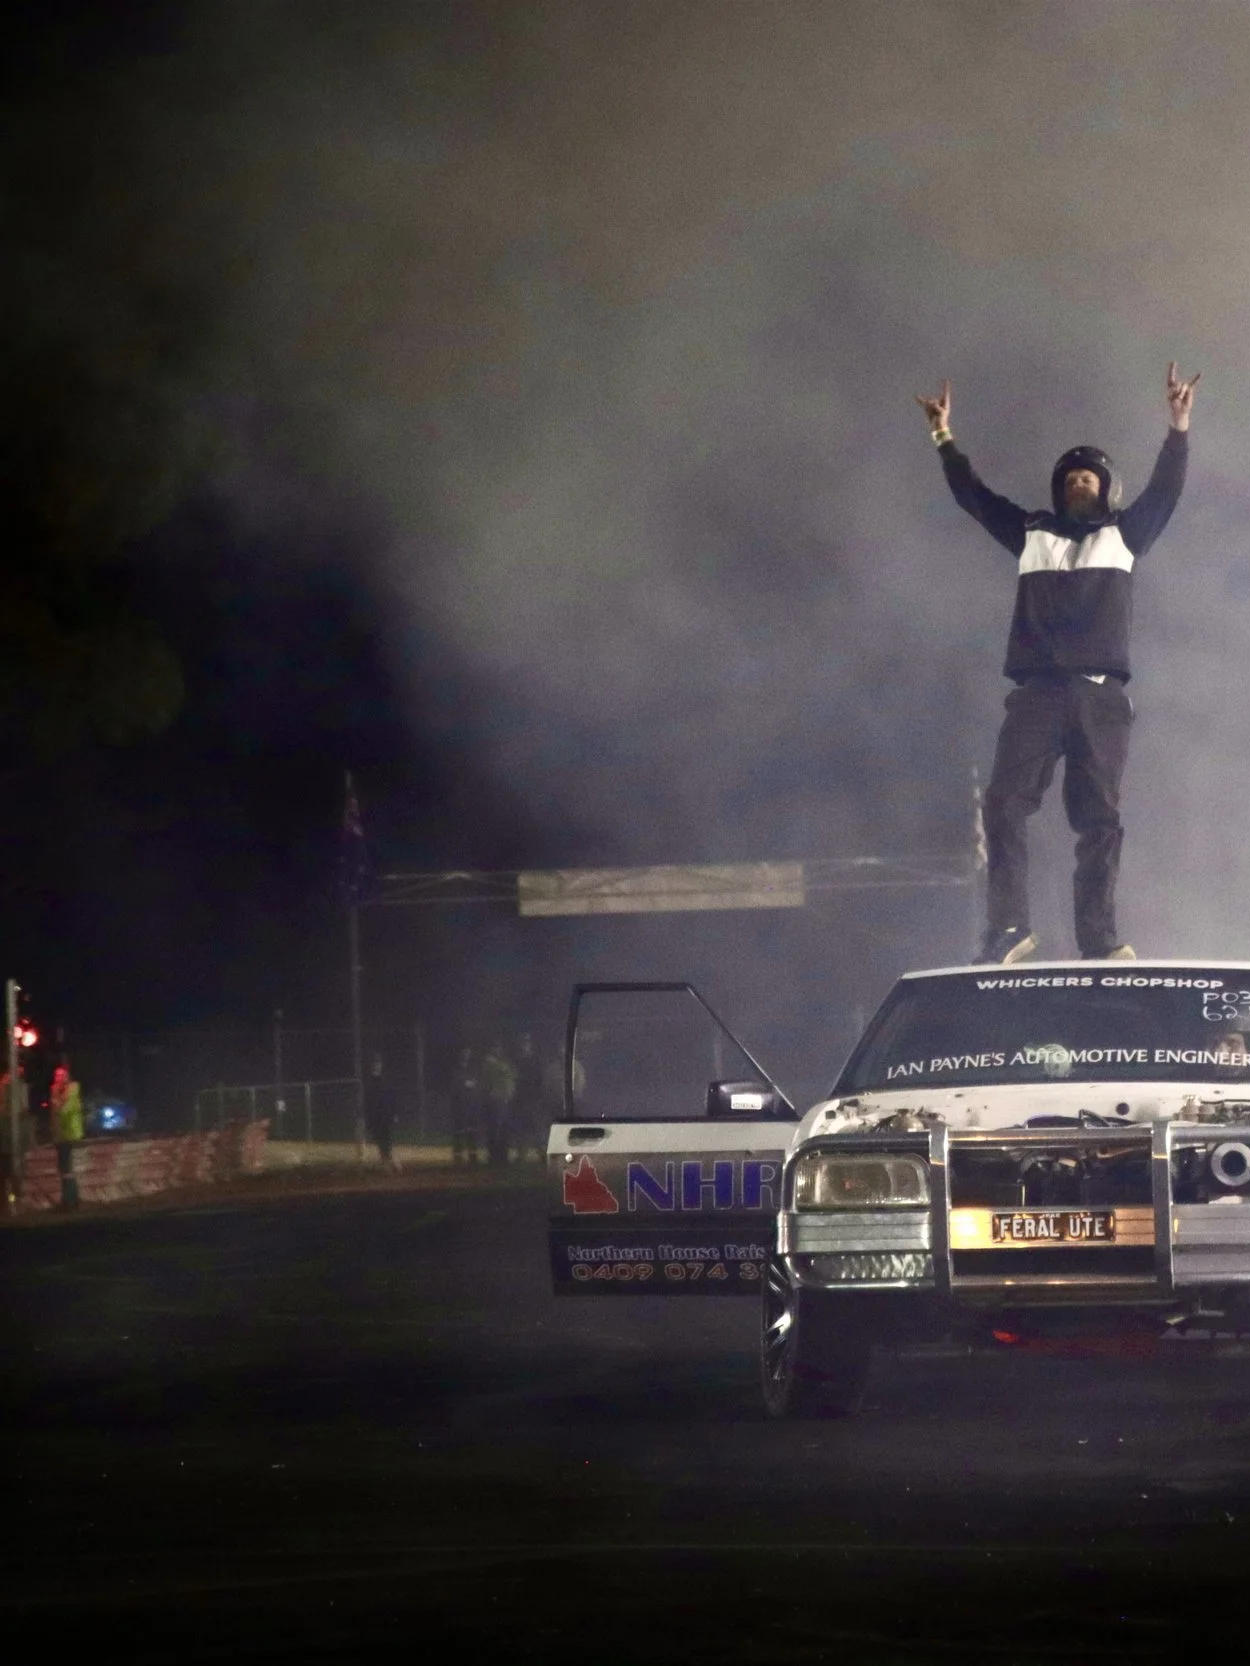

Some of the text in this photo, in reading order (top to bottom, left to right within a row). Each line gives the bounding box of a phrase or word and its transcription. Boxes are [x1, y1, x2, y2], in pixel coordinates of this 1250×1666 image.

[976, 977, 1224, 990] WHICKERS CHOPSHOP
[886, 1061, 924, 1079] IAN
[930, 1052, 1005, 1072] PAYNE'S
[1010, 1049, 1148, 1066] AUTOMOTIVE
[627, 1160, 783, 1212] NHR
[1000, 1217, 1106, 1239] FERAL UTE
[568, 1243, 768, 1261] Northern House Rais
[572, 1263, 654, 1280] 0409
[664, 1262, 729, 1280] 074
